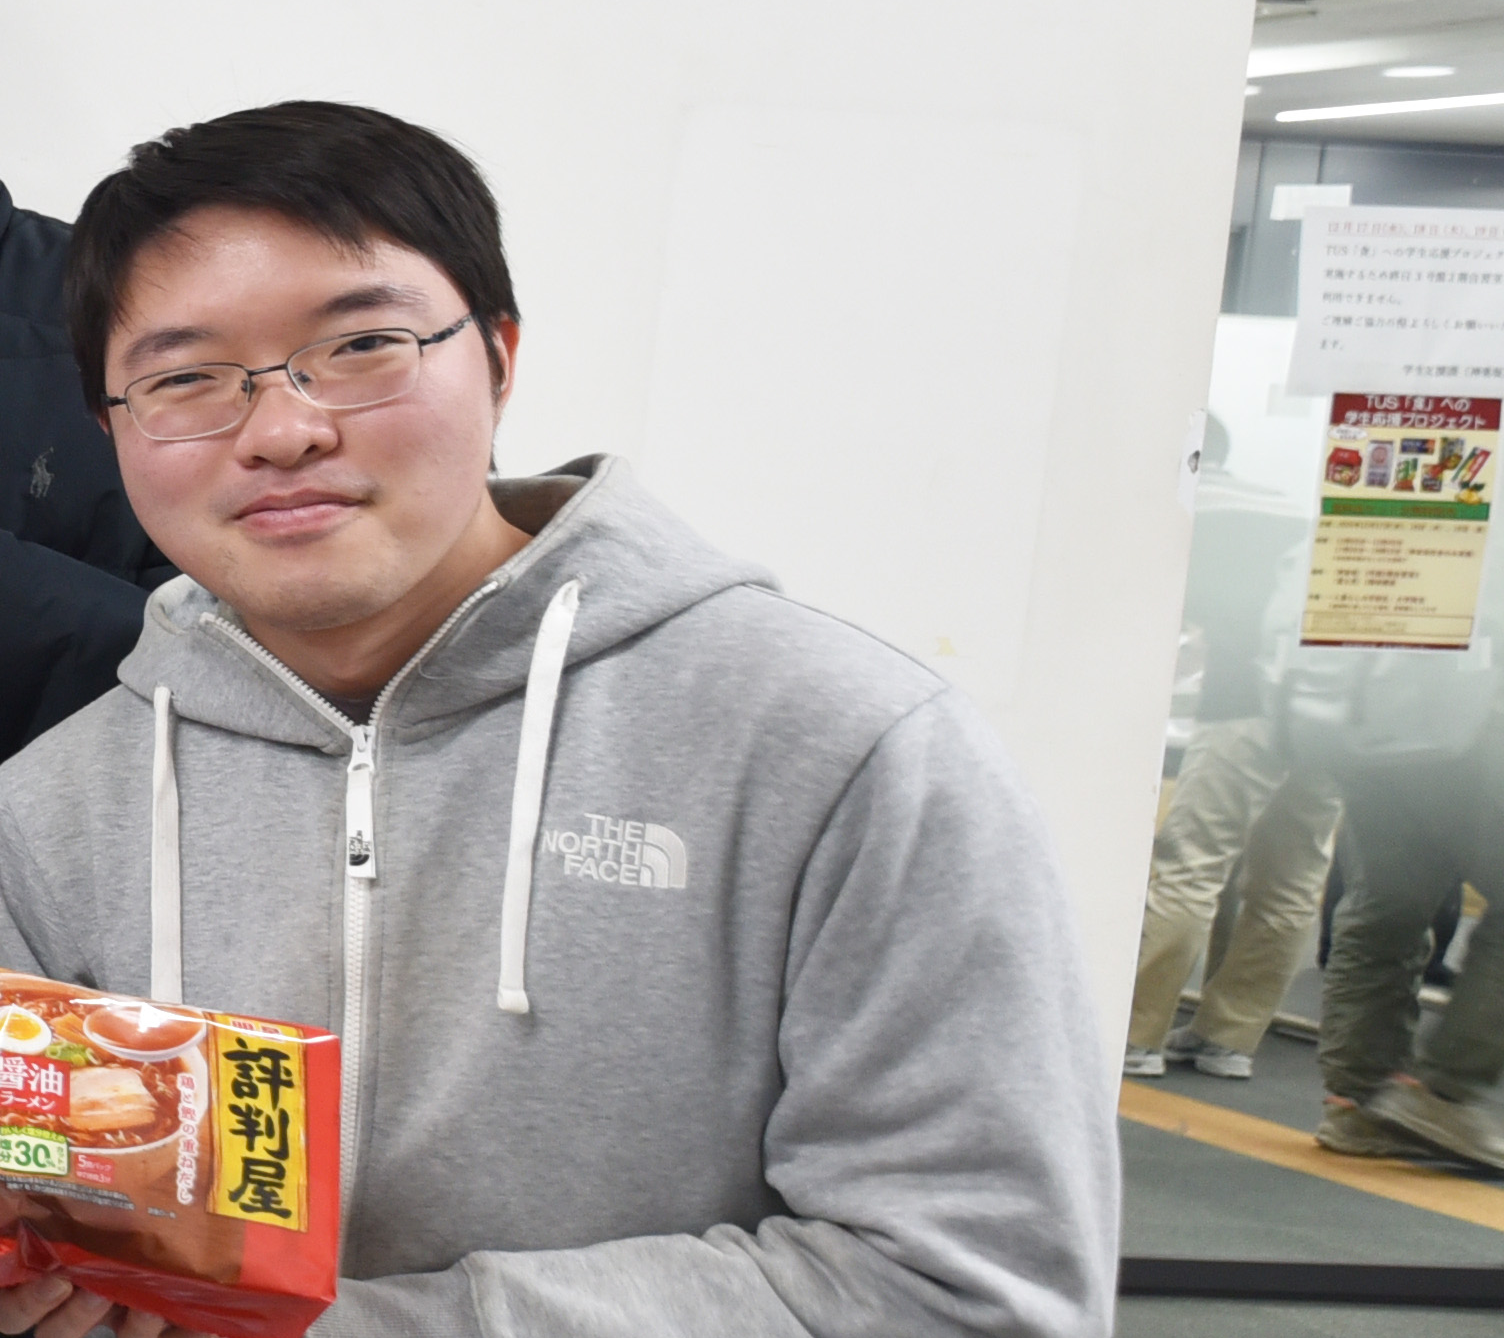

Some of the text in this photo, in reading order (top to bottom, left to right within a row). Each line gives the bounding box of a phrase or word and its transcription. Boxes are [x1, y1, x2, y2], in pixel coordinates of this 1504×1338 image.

[1344, 411, 1487, 430] 学生応援プロジェクト
[584, 813, 644, 842] THE
[542, 830, 642, 865] NORTH
[564, 853, 639, 885] FACE
[0, 1089, 57, 1111] ラーメン
[222, 1036, 296, 1220] 評判屋
[14, 1139, 57, 1170] 30%
